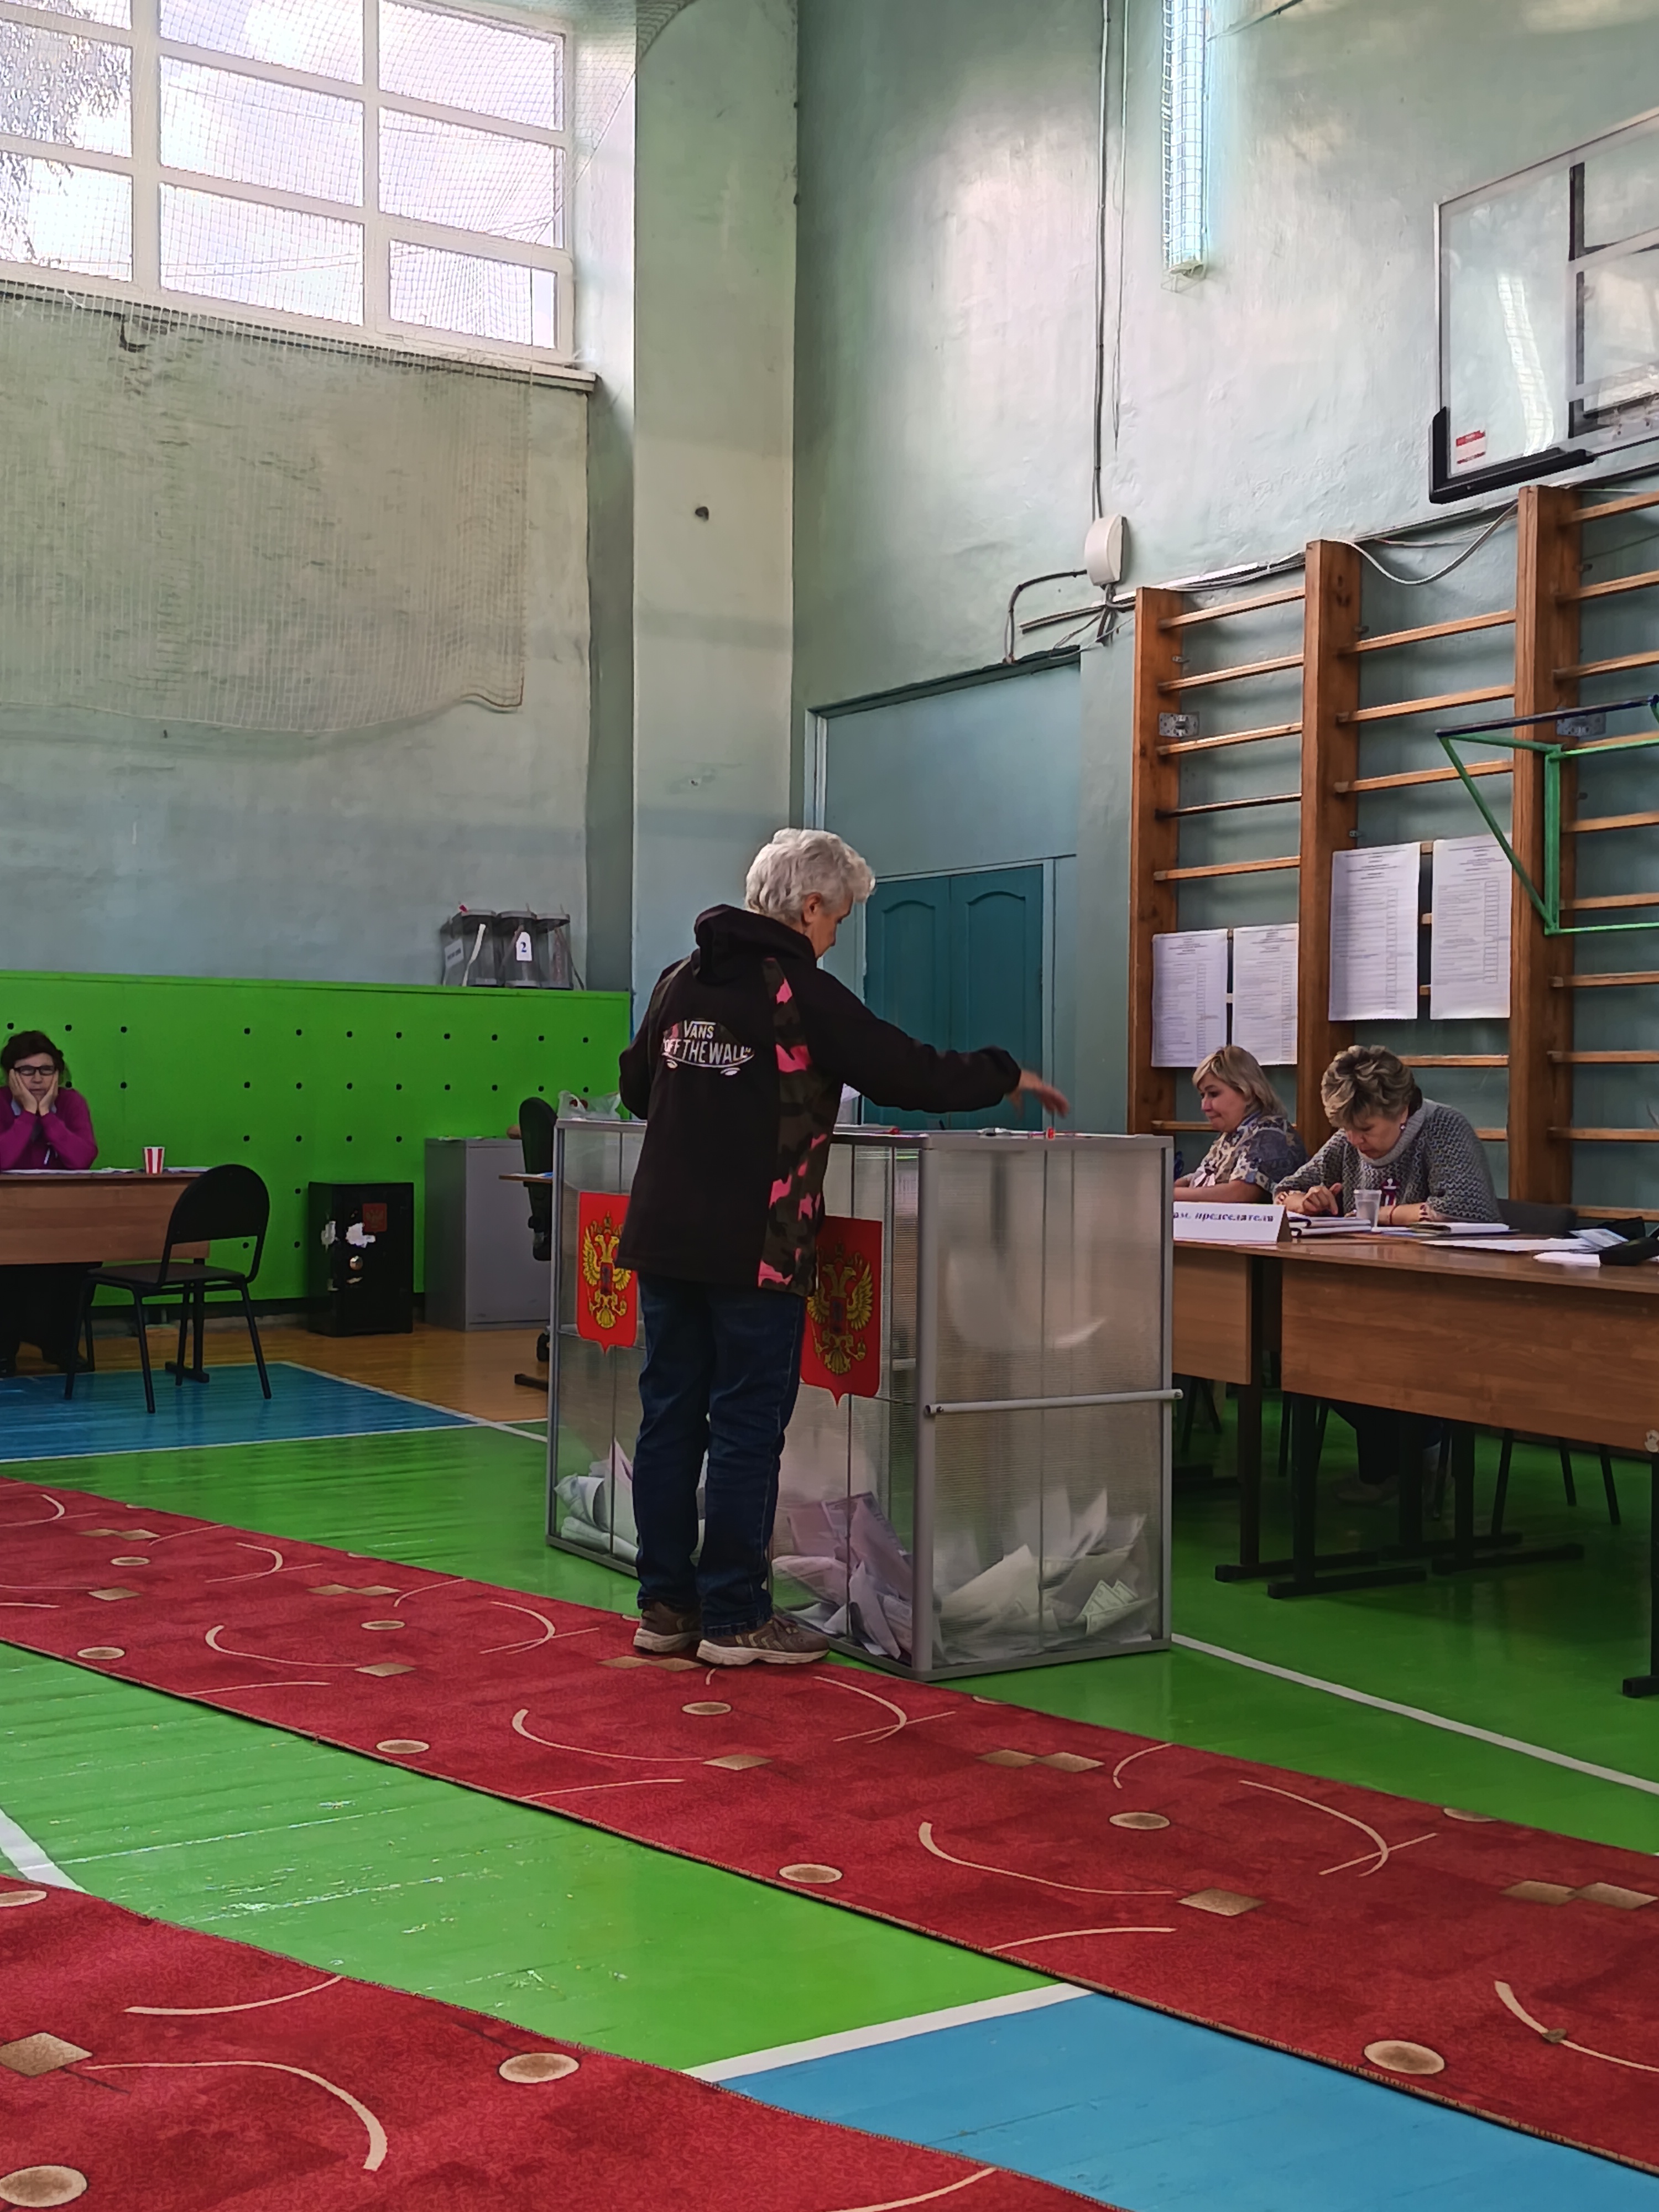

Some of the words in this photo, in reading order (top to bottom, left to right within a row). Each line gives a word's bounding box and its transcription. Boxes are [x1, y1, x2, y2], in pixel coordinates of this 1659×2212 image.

[520, 941, 527, 953] 2
[684, 1020, 716, 1040] VANS
[682, 1039, 708, 1063] THE
